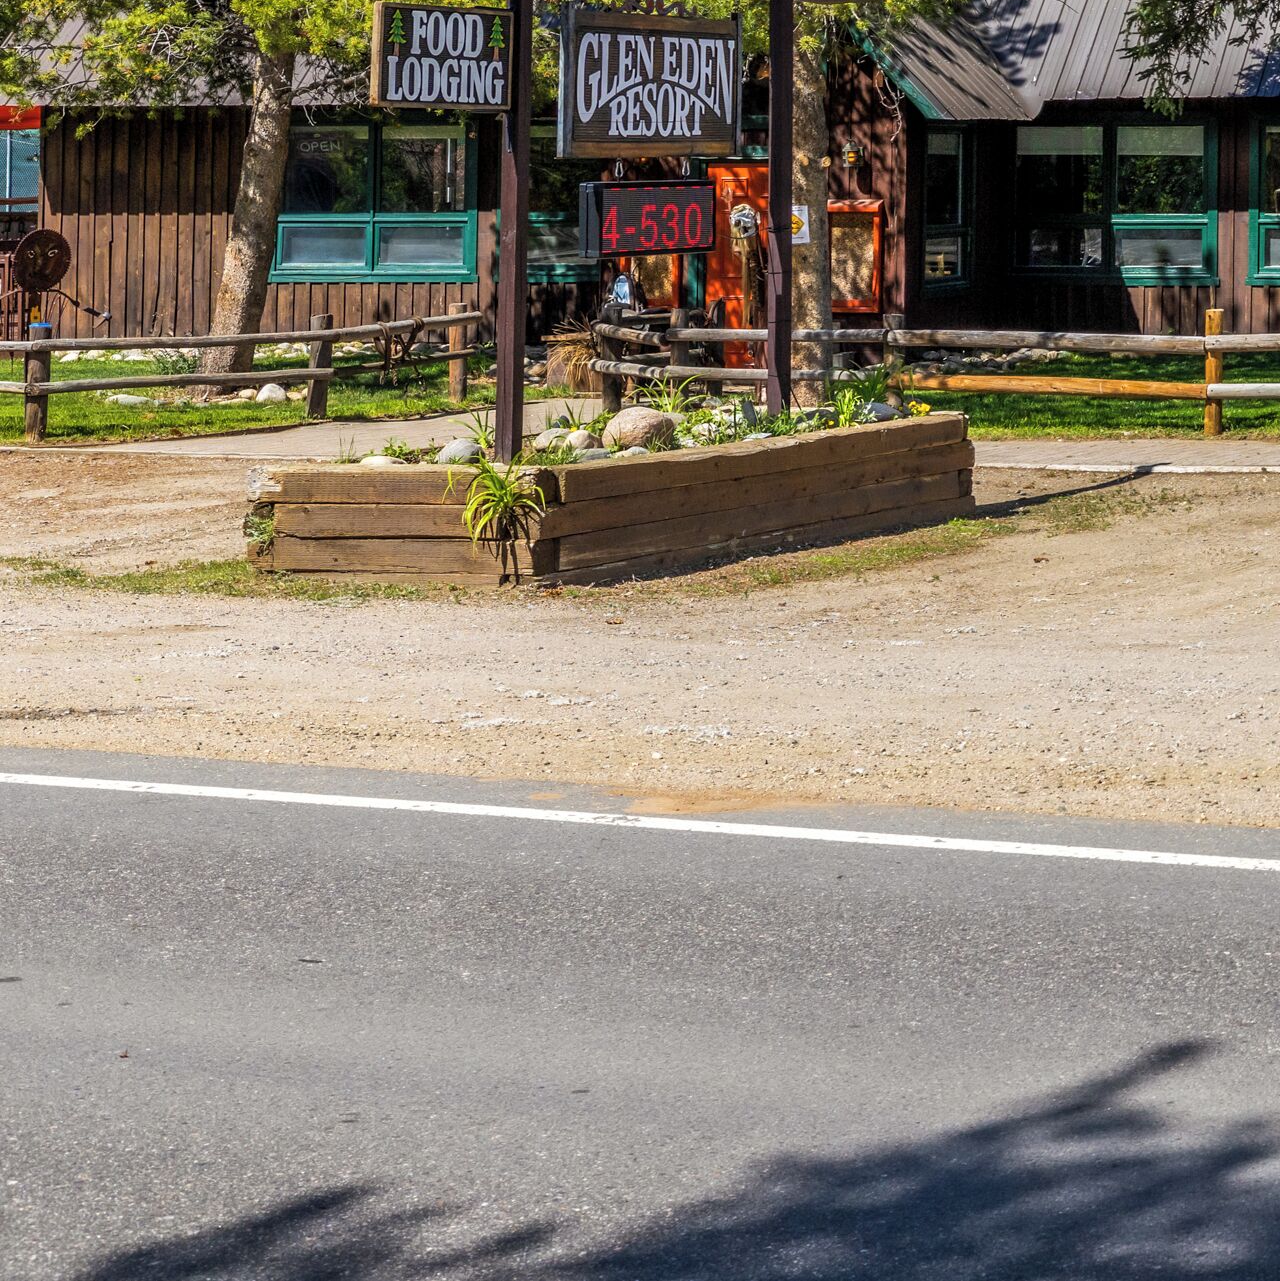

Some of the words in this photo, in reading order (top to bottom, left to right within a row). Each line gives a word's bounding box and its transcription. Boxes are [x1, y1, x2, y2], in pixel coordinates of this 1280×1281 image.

[410, 10, 484, 58] FOOD
[386, 55, 504, 105] LODGING
[576, 32, 655, 123] GLEN
[661, 36, 735, 124] EDEN
[608, 82, 705, 137] RESORT
[300, 141, 341, 152] OPEN
